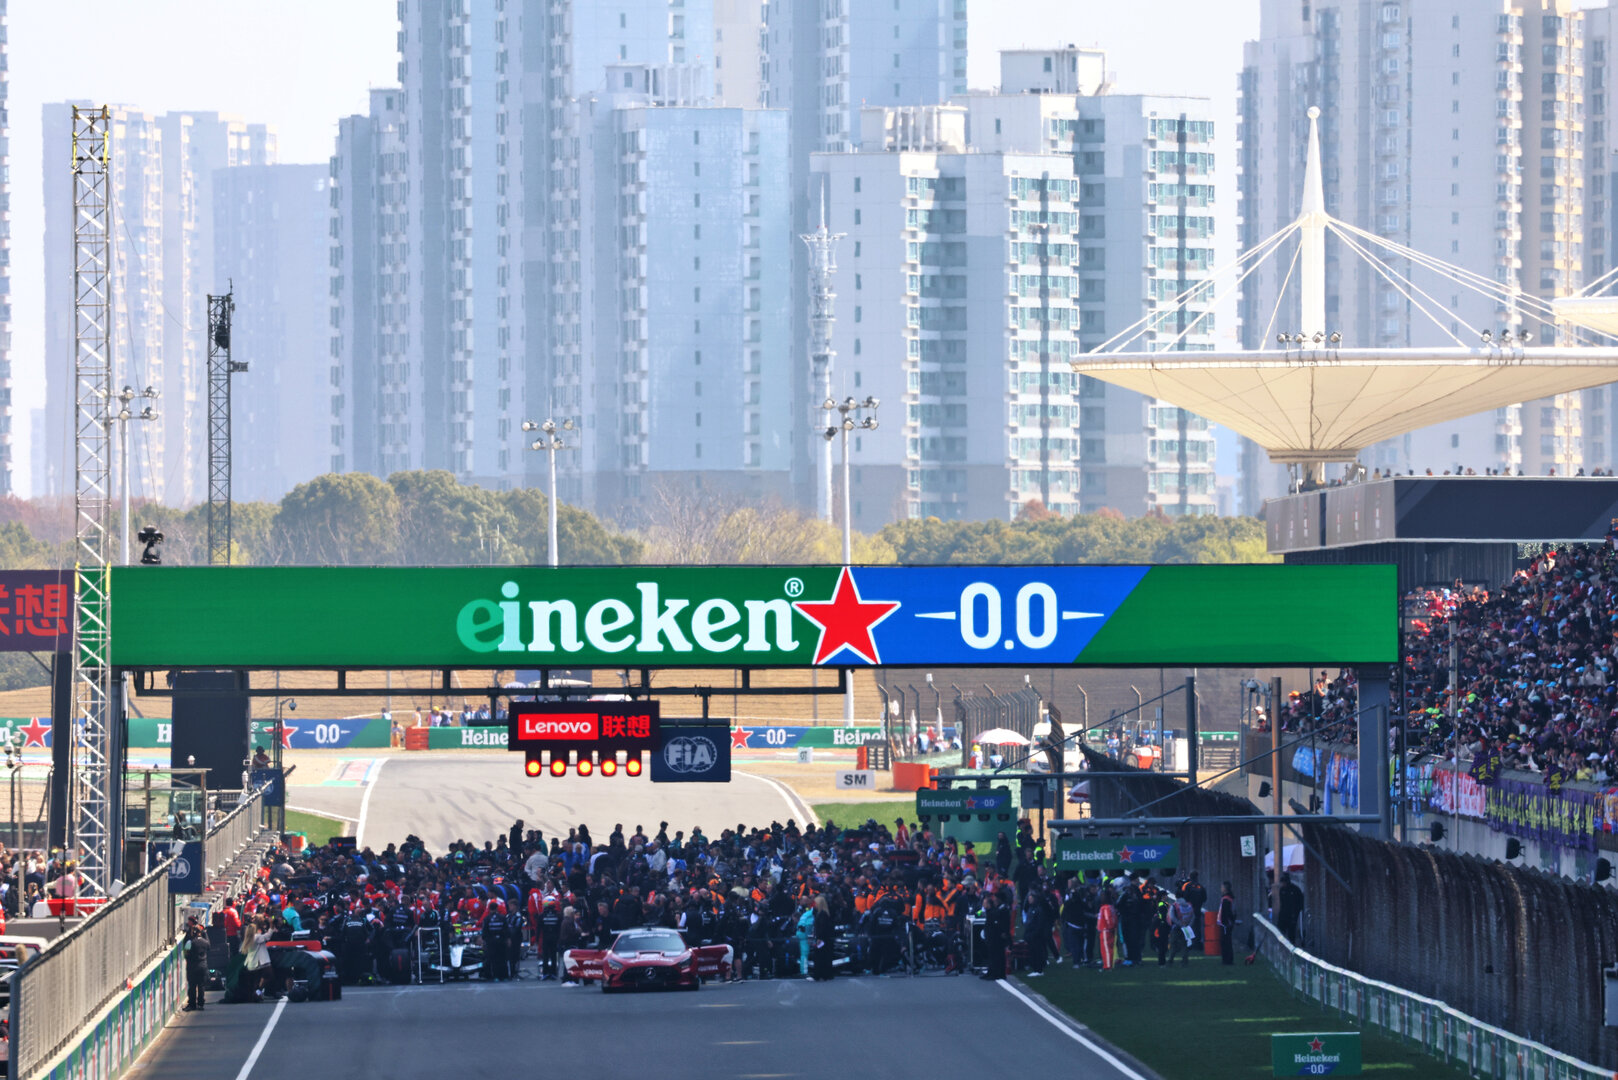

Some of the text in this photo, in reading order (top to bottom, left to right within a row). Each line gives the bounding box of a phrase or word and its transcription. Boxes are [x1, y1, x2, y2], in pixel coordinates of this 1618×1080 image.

[0, 584, 68, 636] 想
[960, 581, 1058, 650] 0.0
[525, 719, 592, 734] Lenovo
[602, 715, 650, 738] 联想
[461, 729, 509, 745] Heine
[844, 774, 867, 786] SM
[1062, 850, 1114, 861] Heineken
[1294, 1053, 1340, 1063] Heineken
